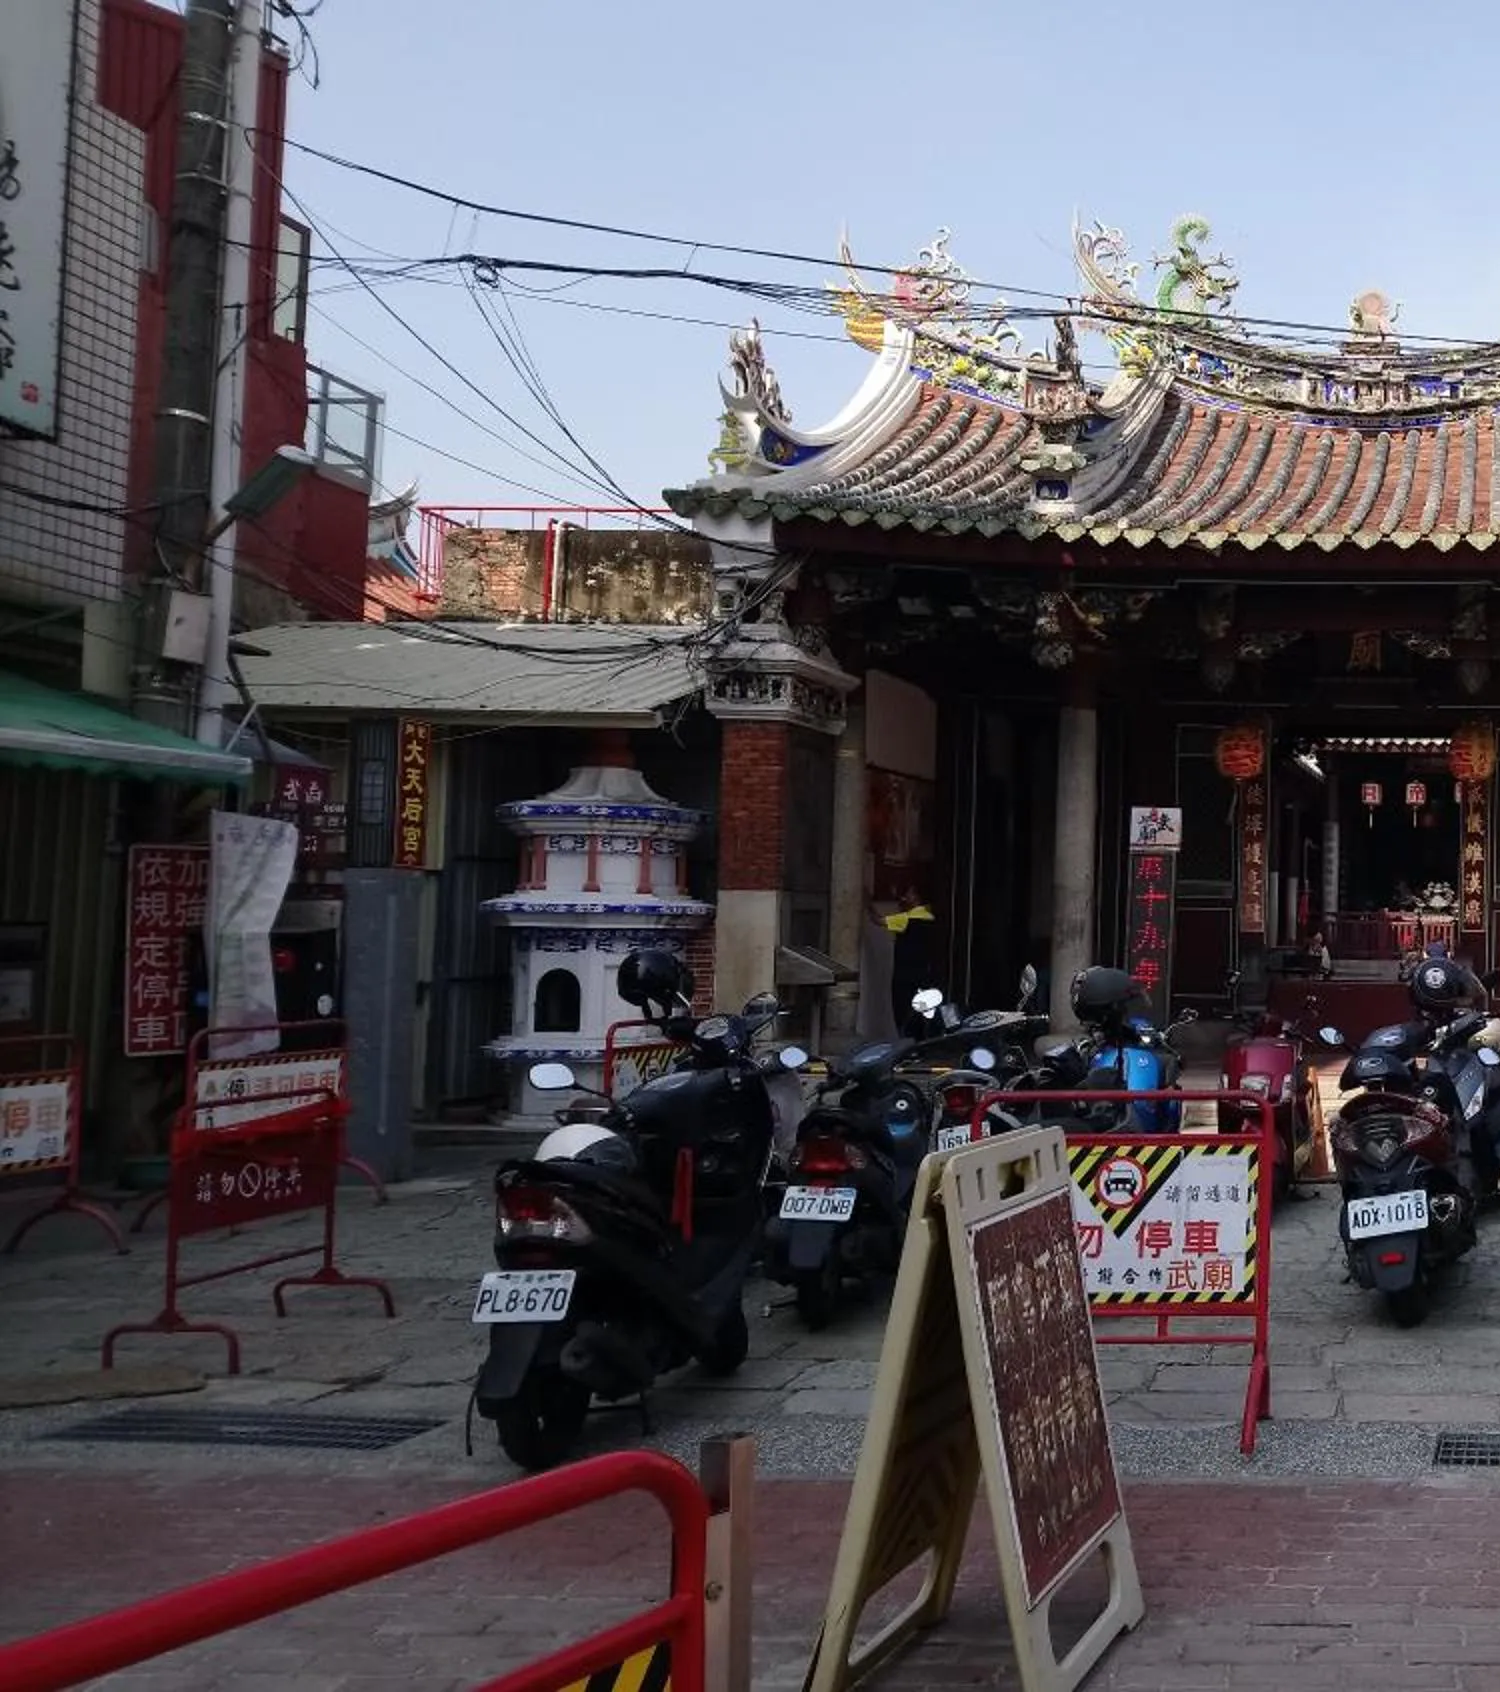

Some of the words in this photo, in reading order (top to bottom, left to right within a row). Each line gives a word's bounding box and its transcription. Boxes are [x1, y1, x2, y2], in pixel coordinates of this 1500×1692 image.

[401, 740, 425, 853] 大天后宮
[132, 852, 172, 1049] 依規定停車
[1351, 1201, 1425, 1229] ADX-1018
[1082, 1267, 1161, 1286] 謝合作
[1166, 1259, 1233, 1291] 武廟
[476, 1287, 568, 1314] PL8-670
